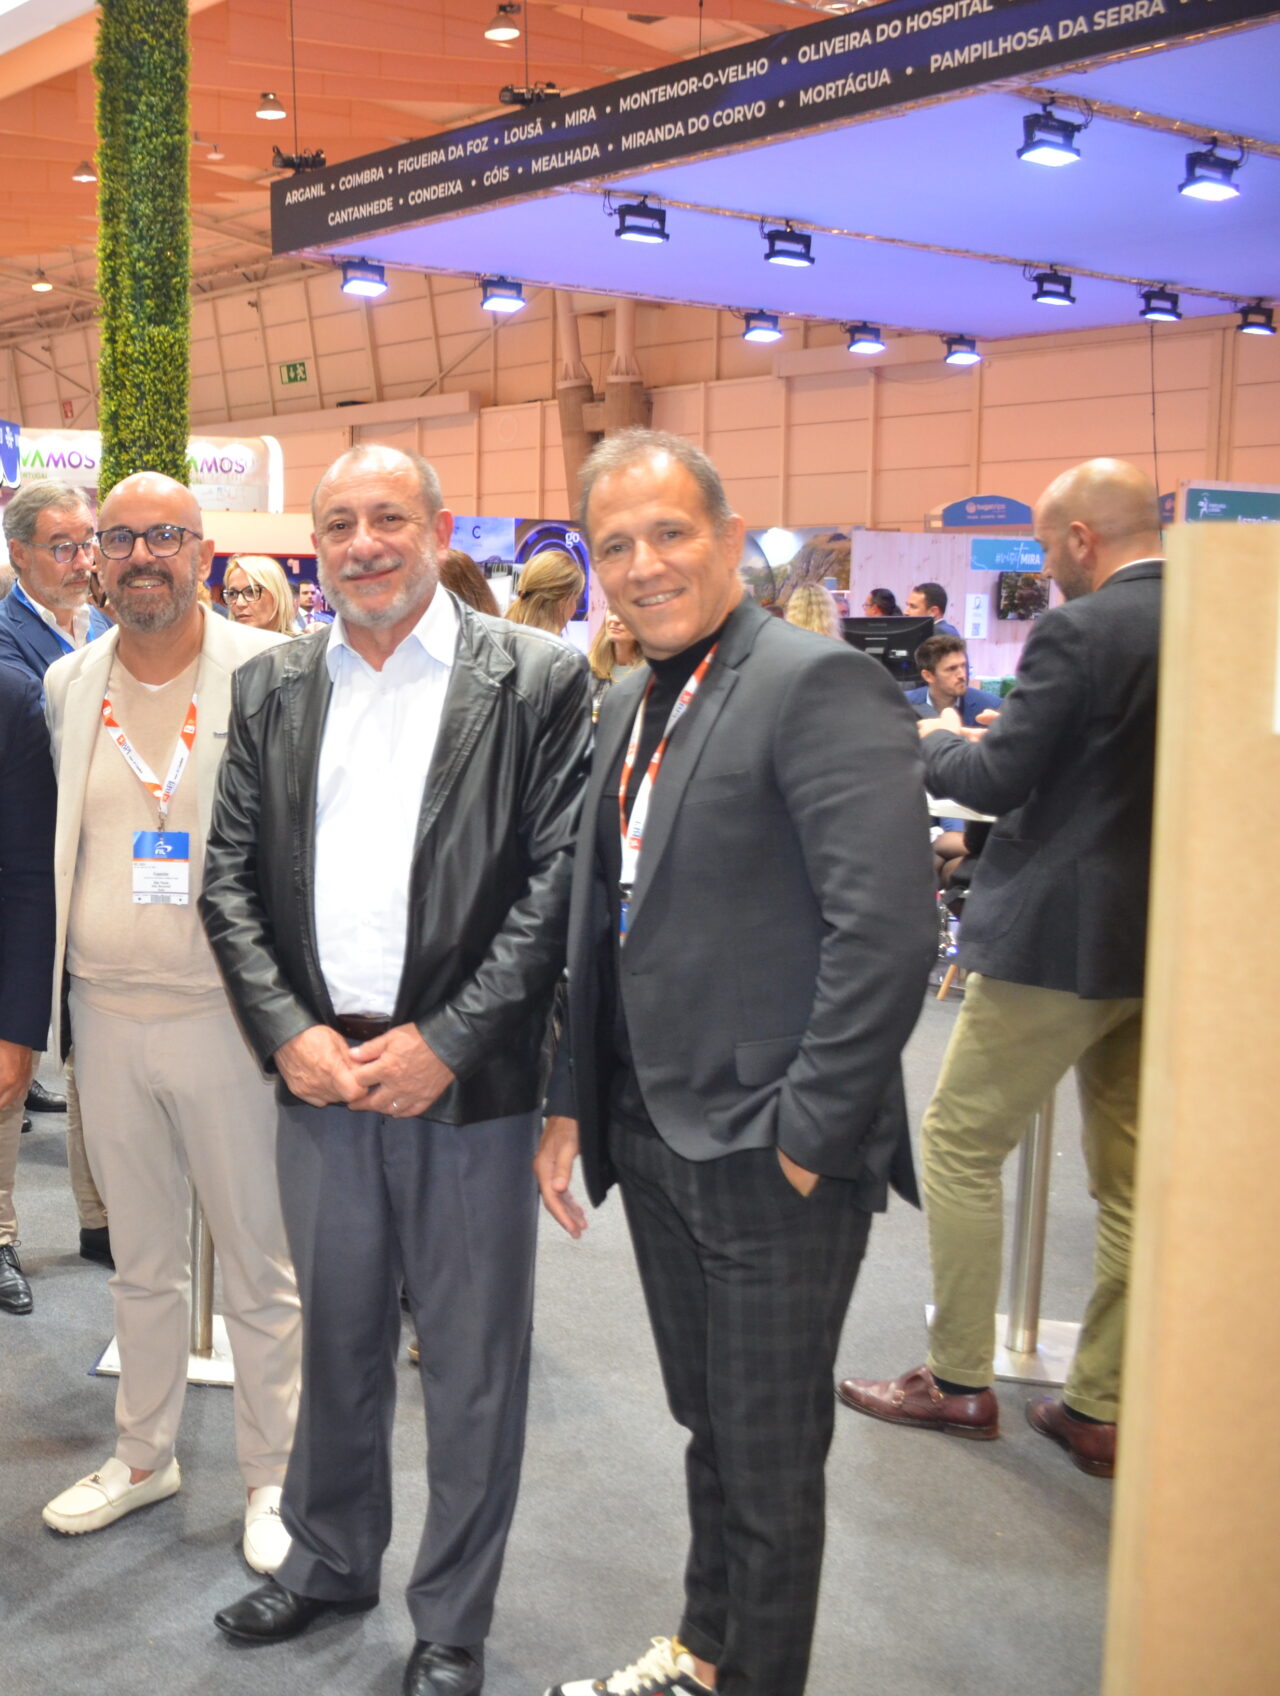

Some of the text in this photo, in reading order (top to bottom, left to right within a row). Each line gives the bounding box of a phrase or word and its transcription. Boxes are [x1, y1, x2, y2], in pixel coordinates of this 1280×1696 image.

[285, 0, 993, 206] ARGANIL COIMBRA FIGUEIRA DA FOZ LOUSÃ MIRA MONTEMOR-O-VELHO OLIVEIRA DO HOSPITAL
[328, 0, 1165, 226] CANTANHEDE CONDEIXA GÓIS MEALHADA MIRANDA DO CORVO MORTÁGUA PAMPILHOSA DA SERRA
[187, 456, 245, 474] AMOS
[565, 532, 580, 548] go
[1020, 553, 1041, 565] MIRA
[121, 742, 132, 755] BPI
